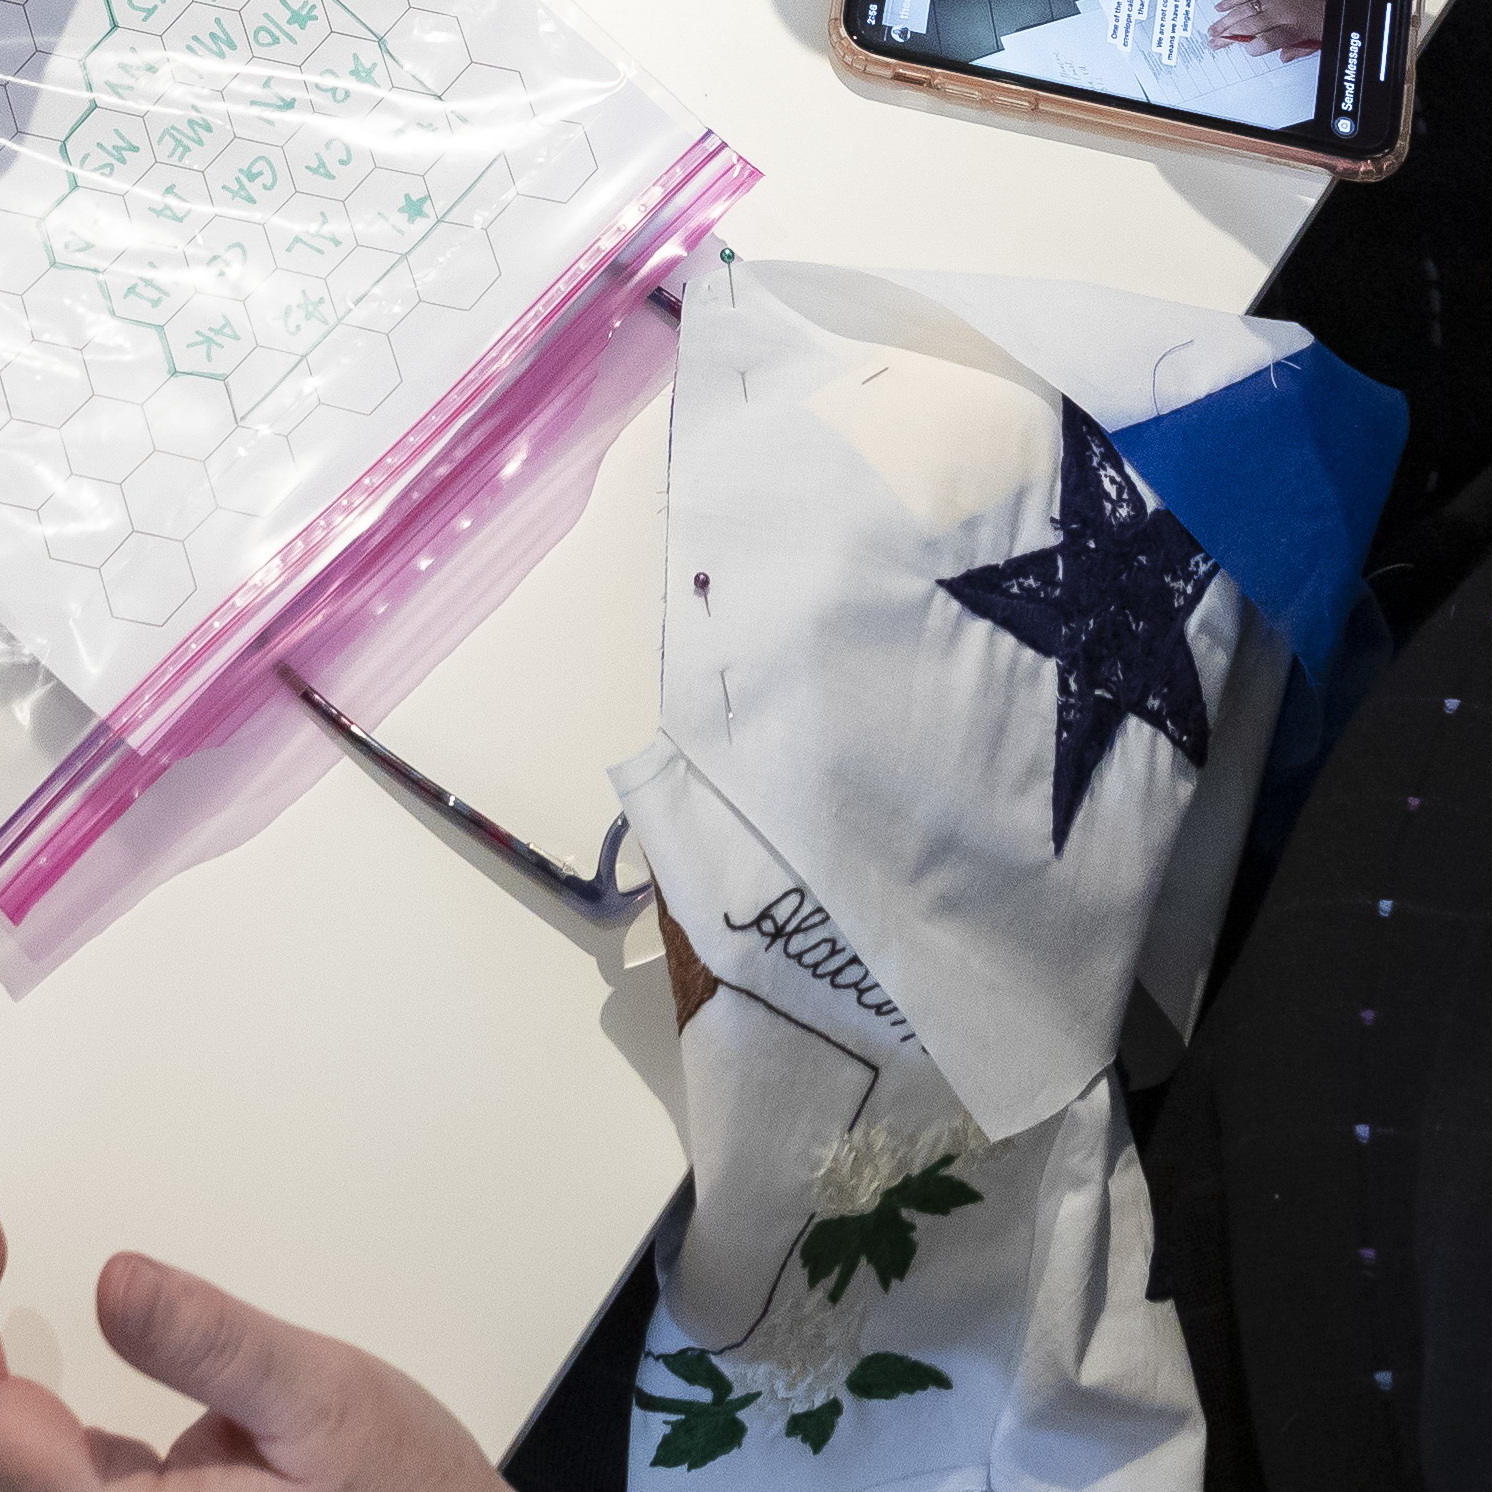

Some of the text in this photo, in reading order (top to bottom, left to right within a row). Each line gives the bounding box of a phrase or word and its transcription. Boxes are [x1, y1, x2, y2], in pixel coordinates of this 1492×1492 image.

[1123, 14, 1133, 47] envelope
[1171, 3, 1179, 22] have
[1171, 24, 1177, 34] we
[1182, 10, 1191, 32] single
[1111, 25, 1119, 39] One
[1156, 37, 1163, 48] We
[1167, 35, 1175, 61] means
[1341, 31, 1362, 112] Send Message
[157, 104, 214, 162] ME
[78, 128, 141, 177] MS
[305, 137, 353, 180] CA
[221, 155, 279, 205] GA
[284, 211, 343, 256] AL
[186, 313, 241, 362] AK
